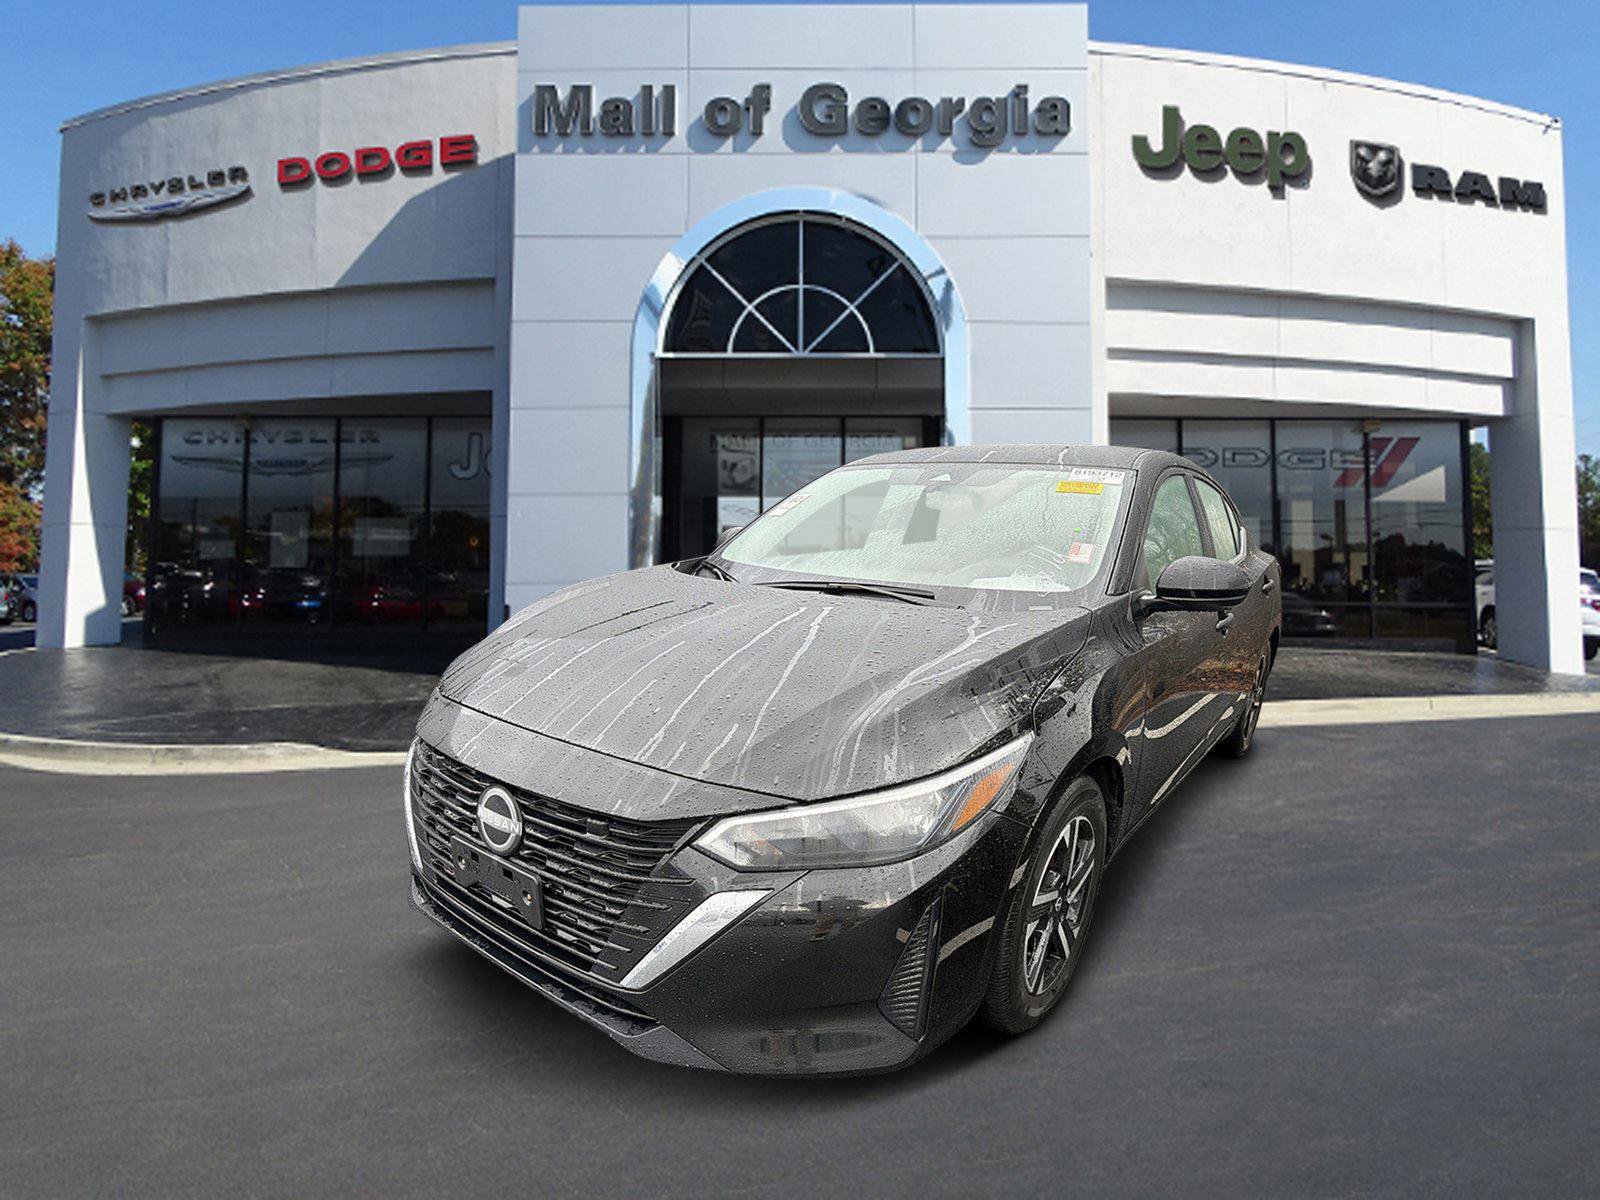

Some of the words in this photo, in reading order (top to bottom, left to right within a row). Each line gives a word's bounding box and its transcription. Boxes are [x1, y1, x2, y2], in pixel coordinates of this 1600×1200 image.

[533, 84, 677, 137] Mall
[704, 84, 772, 137] of
[799, 83, 1073, 147] Georgia
[277, 134, 477, 188] DODGE
[1131, 105, 1310, 193] Jeep
[89, 166, 250, 207] CHRYSLER
[1411, 162, 1547, 212] RAM
